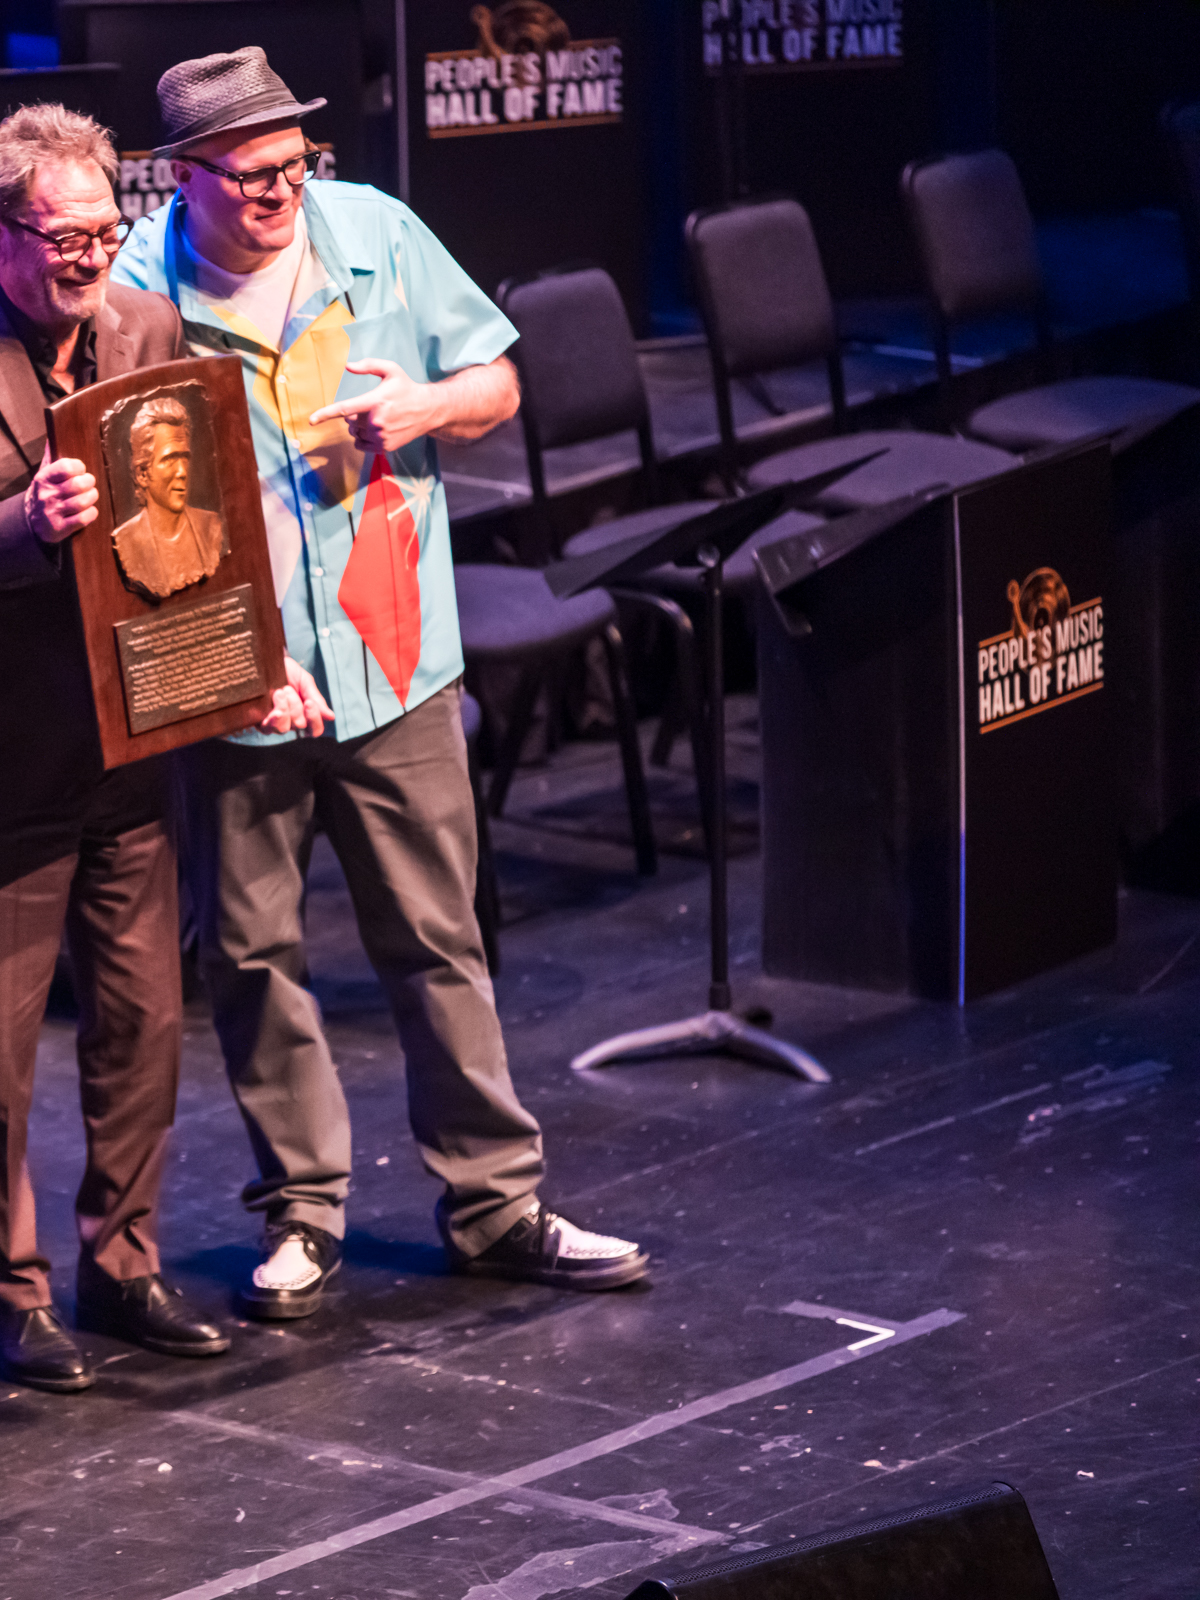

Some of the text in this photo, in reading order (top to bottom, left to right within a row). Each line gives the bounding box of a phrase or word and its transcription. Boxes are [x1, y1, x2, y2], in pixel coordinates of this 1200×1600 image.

[783, 27, 817, 62] OF
[826, 22, 903, 59] FAME
[425, 45, 623, 92] PEOPLE'S MUSIC
[425, 78, 623, 128] HALL OF FAME
[978, 605, 1104, 684] PEOPLE'S MUSIC
[979, 641, 1104, 723] HALL OF FAME
